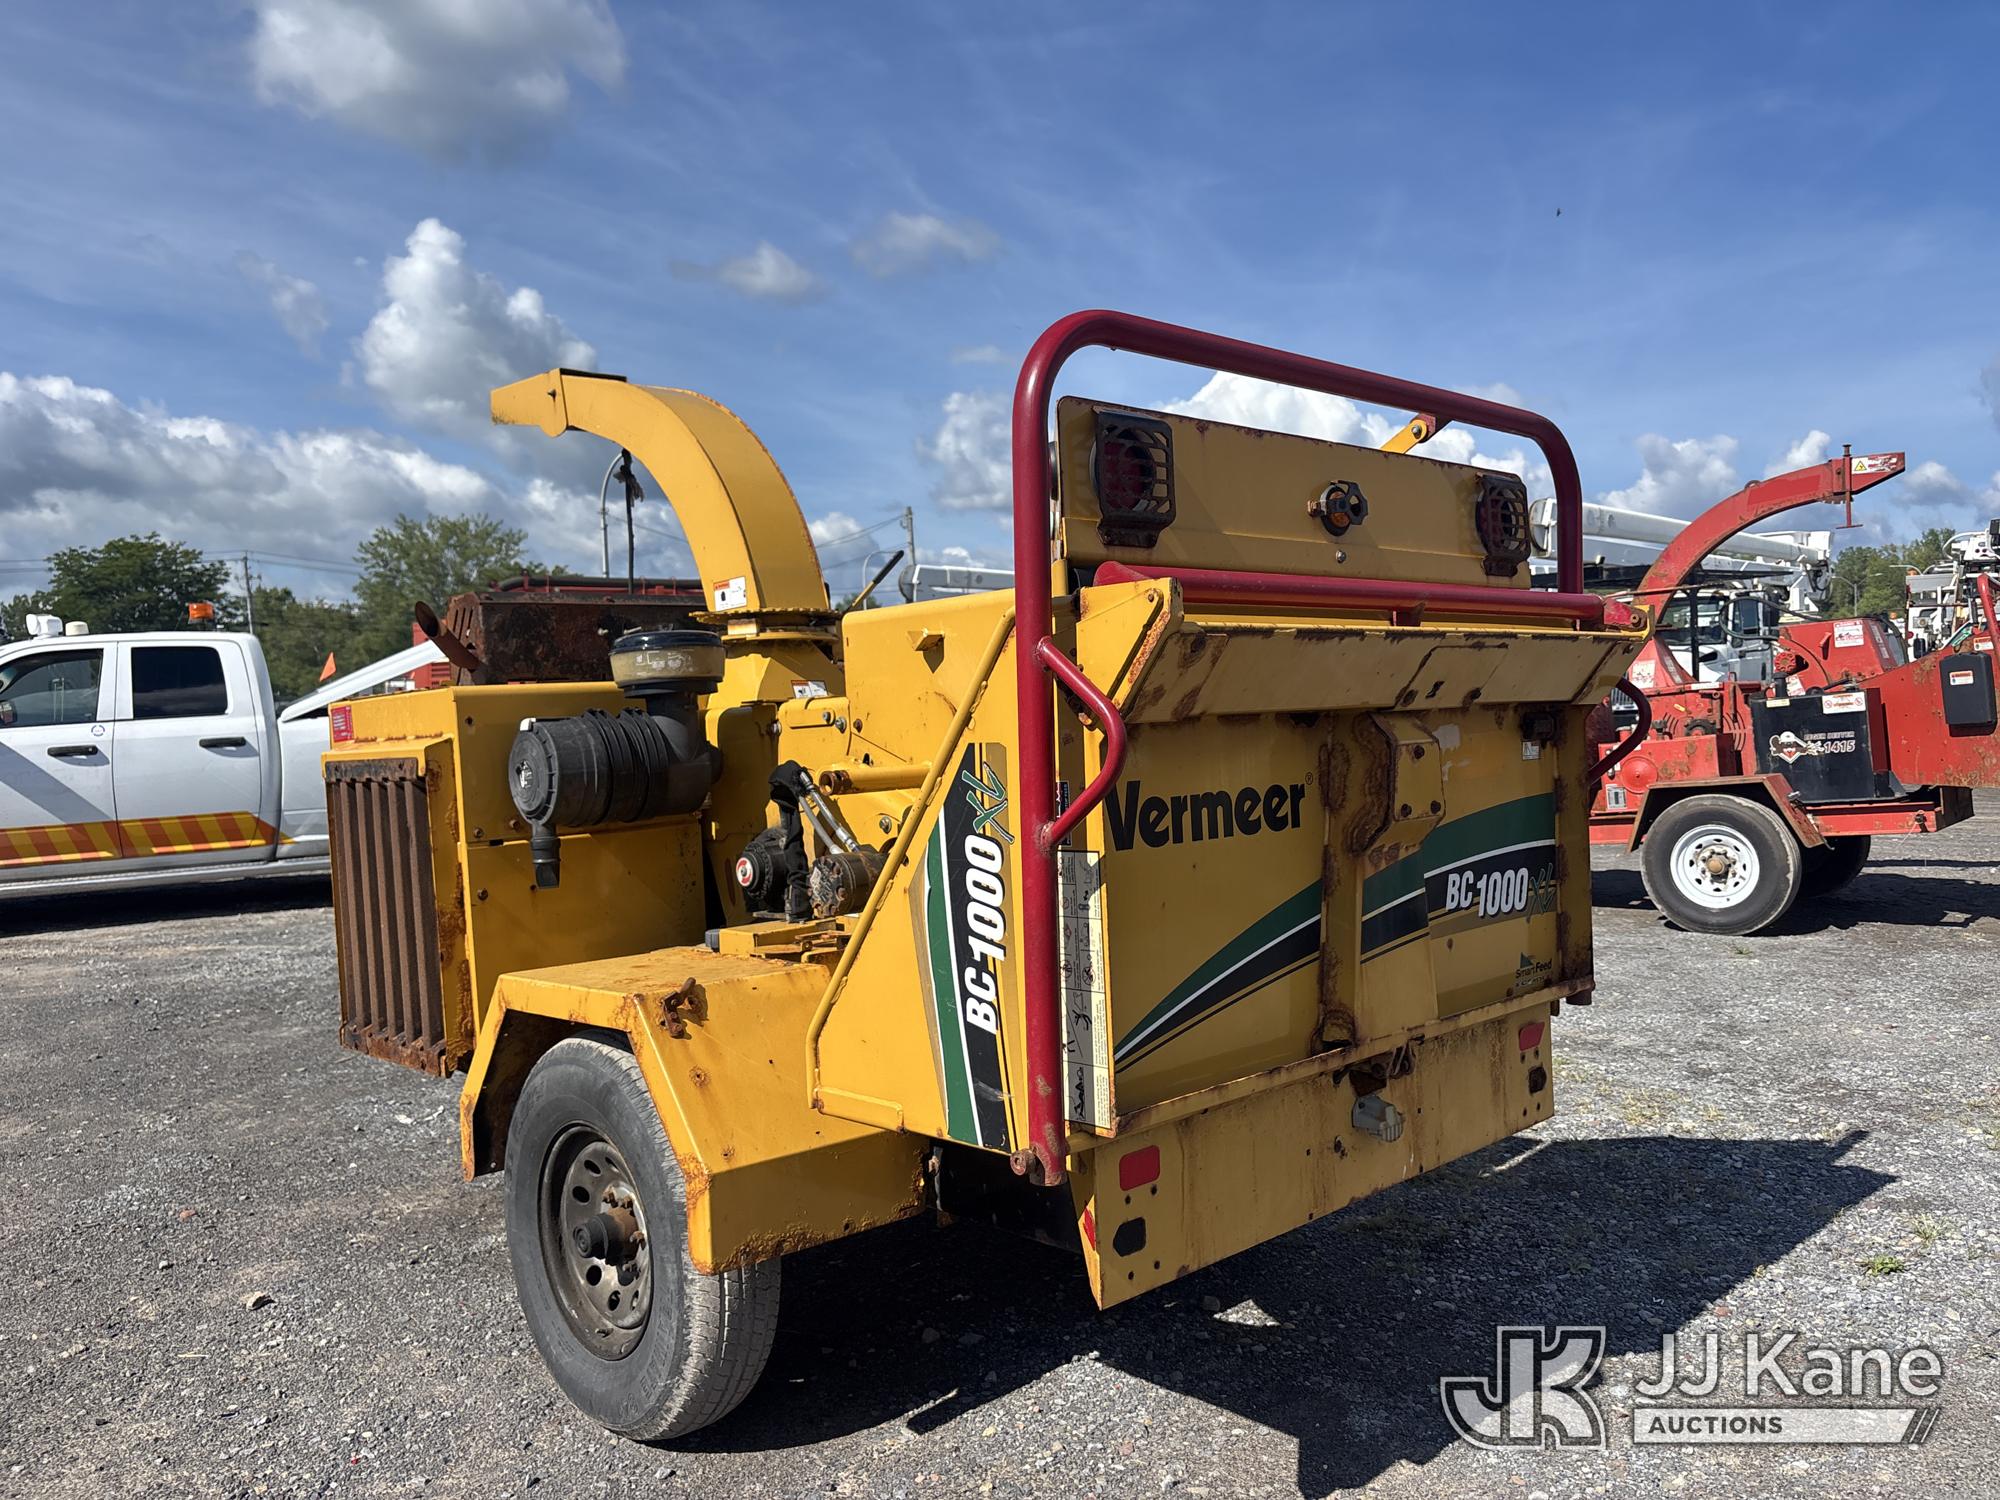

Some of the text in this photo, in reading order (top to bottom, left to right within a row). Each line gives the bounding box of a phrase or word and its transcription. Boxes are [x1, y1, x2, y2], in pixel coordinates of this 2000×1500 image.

[1824, 740, 1855, 753] 1415
[961, 761, 1015, 843] XL
[1105, 780, 1306, 851] Vermeer
